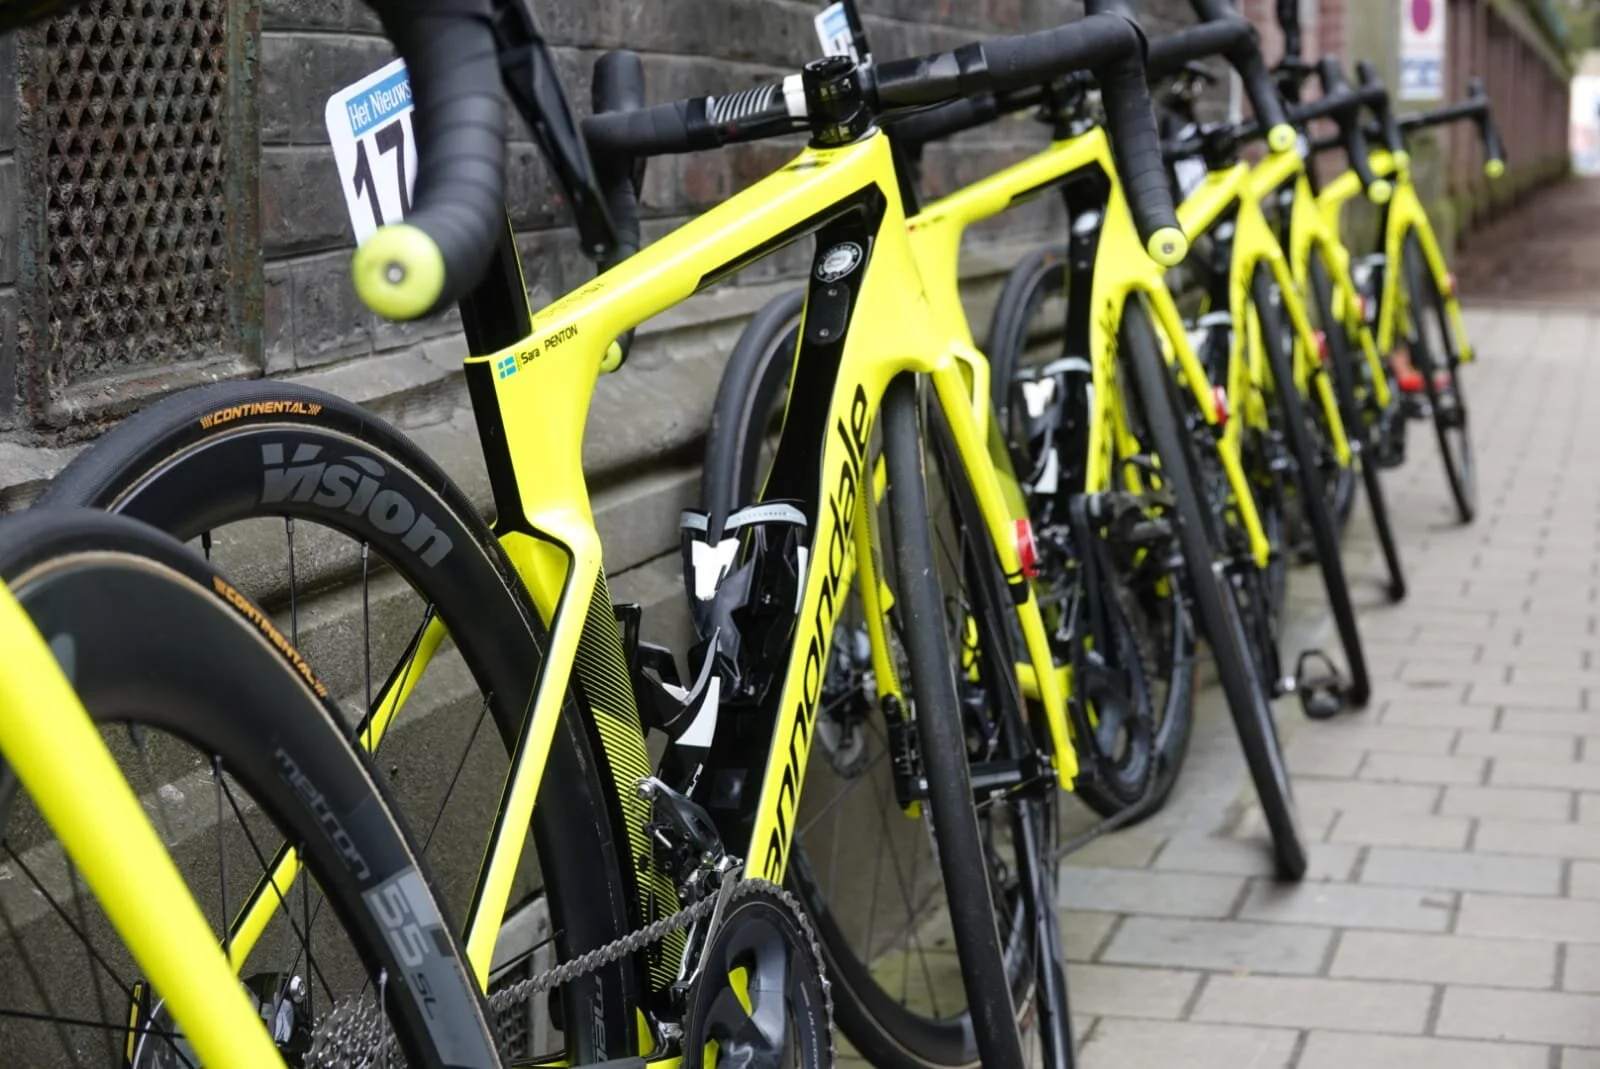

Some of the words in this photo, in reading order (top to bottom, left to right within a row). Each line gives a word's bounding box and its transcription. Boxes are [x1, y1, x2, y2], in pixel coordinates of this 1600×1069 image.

[349, 100, 372, 131] Het
[520, 347, 541, 365] Sara
[544, 324, 578, 352] PENTON
[213, 401, 307, 424] CONTINENTAL
[261, 443, 453, 568] Vision
[225, 586, 316, 686] CONTINENTAL
[275, 748, 371, 881] metron
[370, 883, 430, 969] 55
